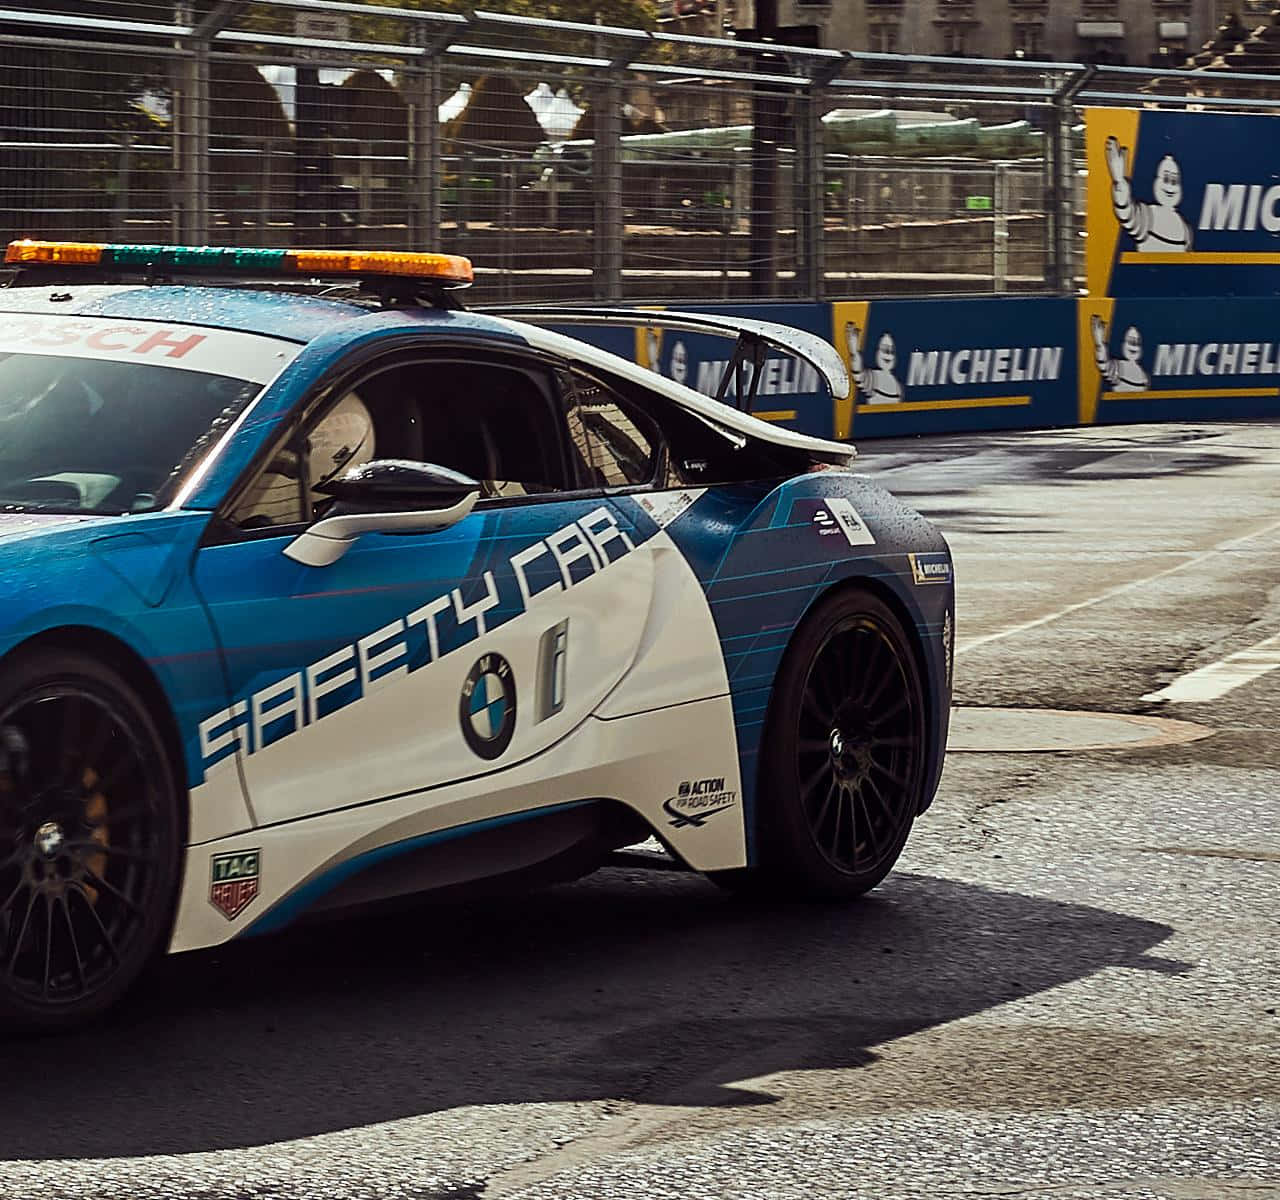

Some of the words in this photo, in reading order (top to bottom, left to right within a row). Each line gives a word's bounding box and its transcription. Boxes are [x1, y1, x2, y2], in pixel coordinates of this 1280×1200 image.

[905, 347, 1063, 387] MICHELIN
[198, 571, 501, 759] SAFETY
[510, 506, 636, 610] CAR
[690, 778, 724, 796] ACTION
[709, 791, 736, 806] SAFETY
[215, 855, 256, 879] TAG
